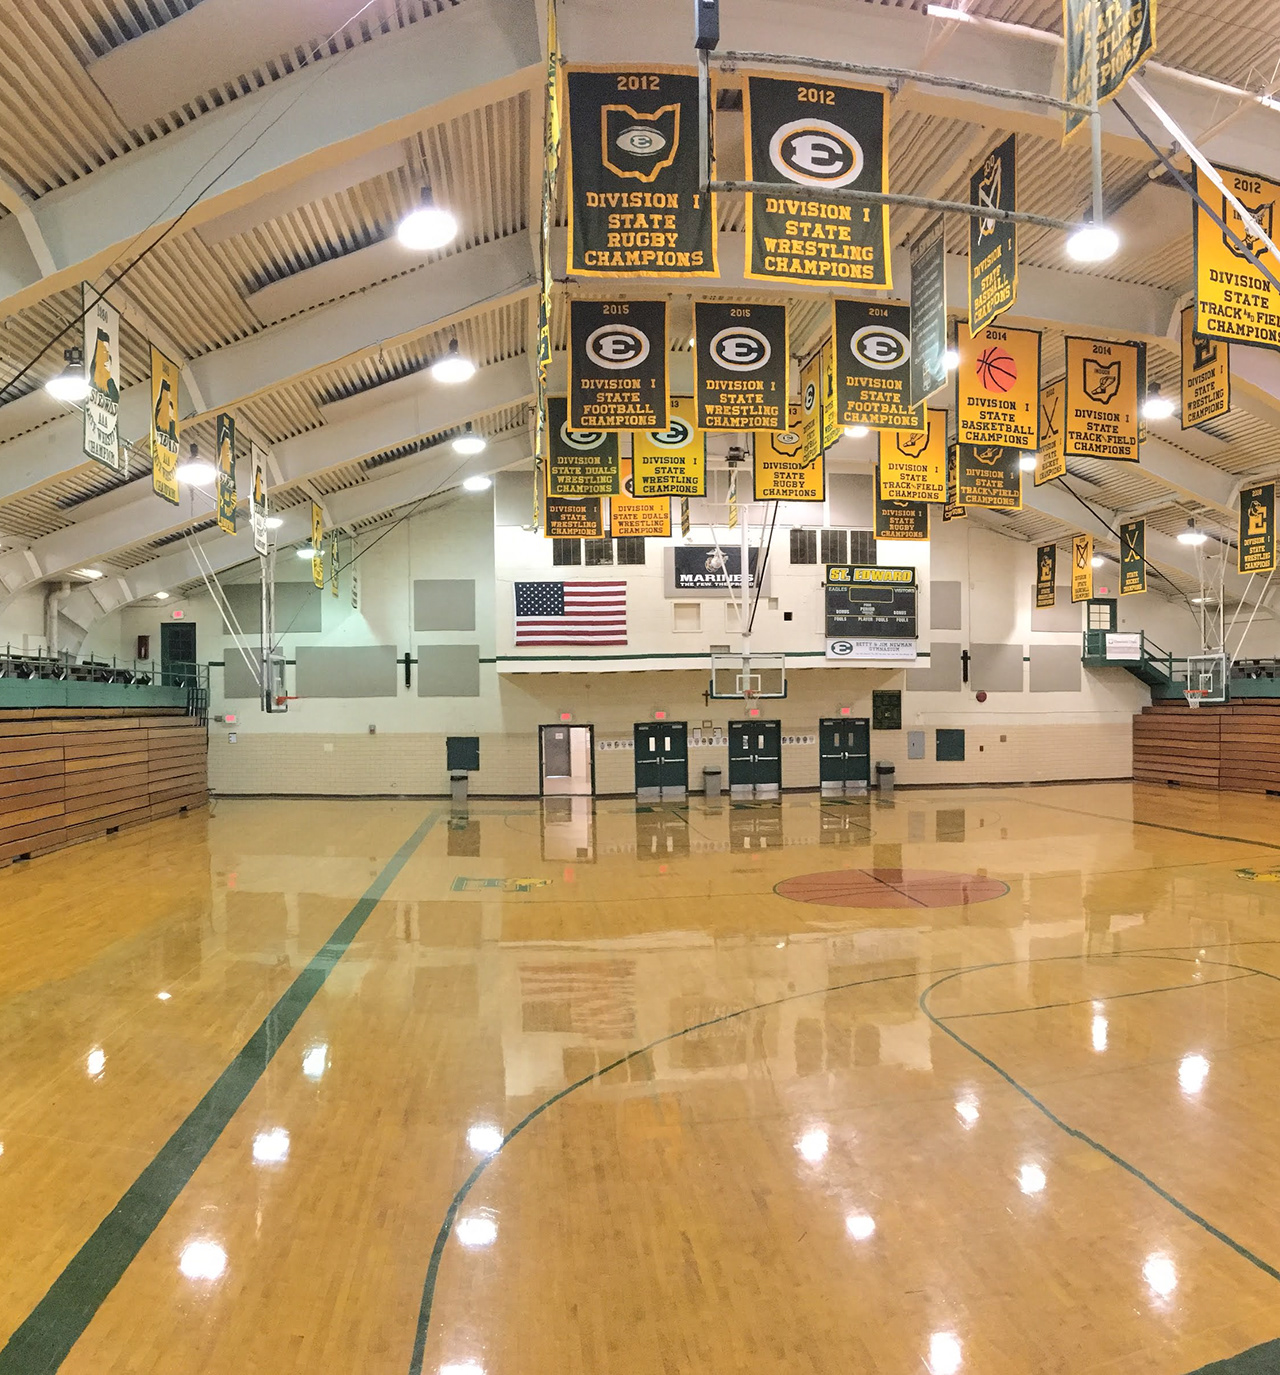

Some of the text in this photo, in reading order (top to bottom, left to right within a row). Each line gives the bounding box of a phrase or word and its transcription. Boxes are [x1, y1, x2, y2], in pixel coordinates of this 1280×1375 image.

[617, 76, 659, 90] 2012
[797, 88, 835, 105] 2012
[791, 135, 843, 174] E
[1234, 178, 1261, 194] 2012
[587, 192, 699, 209] DIVISION I
[766, 198, 870, 222] DIVISION I
[609, 214, 676, 229] STATE
[786, 222, 851, 241] STATE
[607, 232, 678, 248] RUGBY
[764, 238, 873, 261] WRESTLING
[584, 250, 703, 267] CHAMPIONS
[974, 245, 1002, 279] DIVISION
[764, 256, 874, 279] CHAMPIONS
[981, 264, 1001, 290] STATE
[1210, 269, 1270, 292] DIVISION
[974, 285, 1010, 323] CHAMPIONS
[1224, 291, 1269, 309] STATE
[603, 305, 629, 314] 2015
[730, 309, 750, 317] 2015
[869, 308, 888, 317] 2014
[1200, 301, 1242, 319] TRACK
[986, 331, 1007, 341] 2014
[1093, 345, 1111, 355] 2014
[581, 379, 656, 389] DIVISION I
[846, 377, 902, 390] DIVISION
[1188, 368, 1215, 387] DIVISION
[706, 380, 775, 391] DIVISION I
[1195, 382, 1215, 397] STATE
[597, 393, 640, 402] STATE
[720, 394, 763, 404] STATE
[860, 391, 900, 402] STATE
[1188, 389, 1224, 410] WRESTLING
[583, 404, 653, 414] FOOTBALL
[847, 401, 916, 415] FOOTBALL
[967, 397, 1016, 410] DIVISION
[705, 405, 778, 416] WRESTLING
[979, 411, 1015, 422] STATE
[1075, 409, 1120, 422] DIVISION
[1188, 400, 1223, 422] CHAMPIONS
[581, 416, 656, 425] CHAMPIONS
[706, 417, 778, 427] CHAMPIONS
[844, 412, 918, 427] CHAMPIONS
[962, 420, 1034, 435] BASKETBALL
[1087, 423, 1118, 434] STATE
[966, 432, 1028, 445] CHAMPIONS
[1074, 442, 1131, 455] CHAMPIONS
[888, 463, 927, 472] DIVISION
[966, 469, 1003, 478] DIVISION
[557, 475, 612, 484] WRESTLING
[642, 476, 698, 485] WRESTLING
[900, 473, 927, 481] STATE
[976, 479, 1003, 488] STATE
[557, 484, 612, 493] CHAMPIONS
[773, 480, 805, 488] RUGBY
[889, 490, 939, 499] CHAMPIONS
[966, 496, 1014, 505] CHAMPIONS
[1250, 546, 1265, 554] STATE
[1245, 552, 1270, 562] WRESTLING
[1245, 561, 1270, 570] CHAMPIONS
[830, 568, 912, 583] ST. EDWARD
